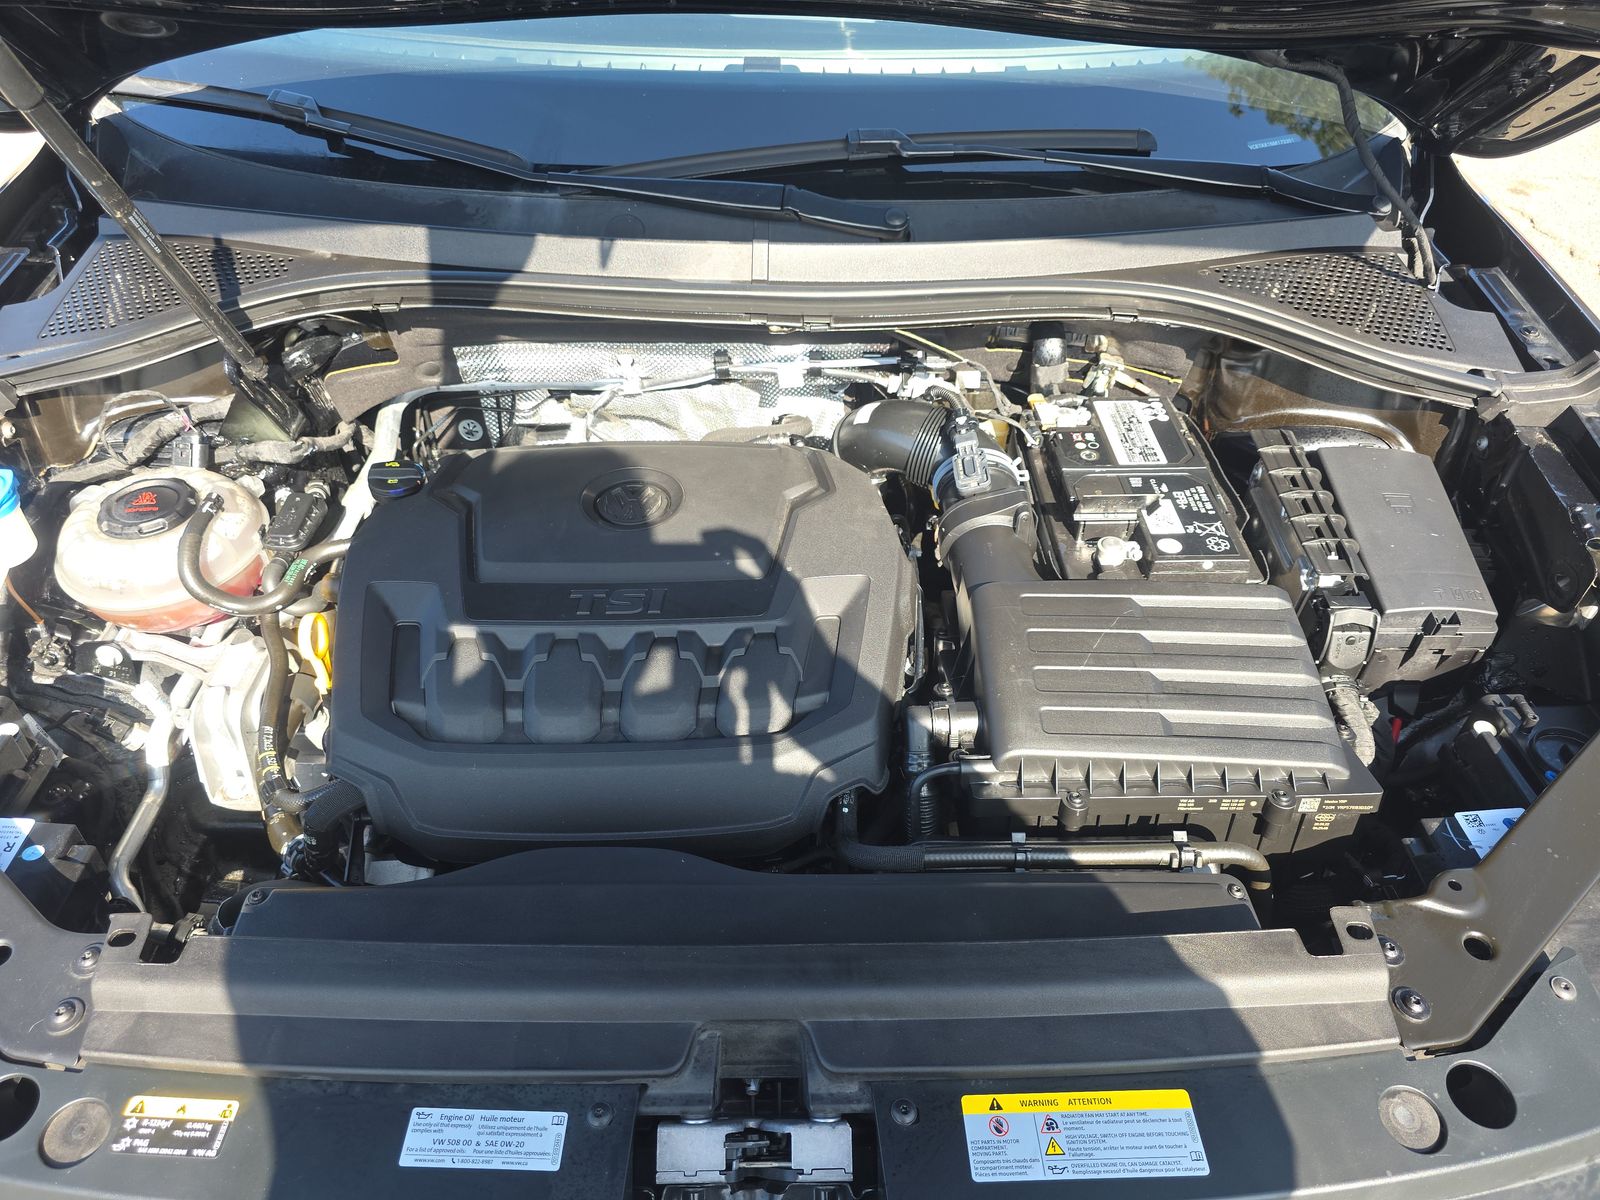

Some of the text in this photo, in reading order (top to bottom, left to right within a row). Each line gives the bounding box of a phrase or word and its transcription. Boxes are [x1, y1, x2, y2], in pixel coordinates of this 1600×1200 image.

[570, 588, 668, 615] TSI
[1019, 1097, 1112, 1107] WARNING ATTENTION
[440, 1113, 463, 1122] Engine
[480, 1114, 525, 1123] Huile moteur
[433, 1138, 446, 1146] VW
[462, 1139, 473, 1147] 00
[484, 1140, 499, 1148] SAE
[500, 1140, 525, 1148] 0W-20
